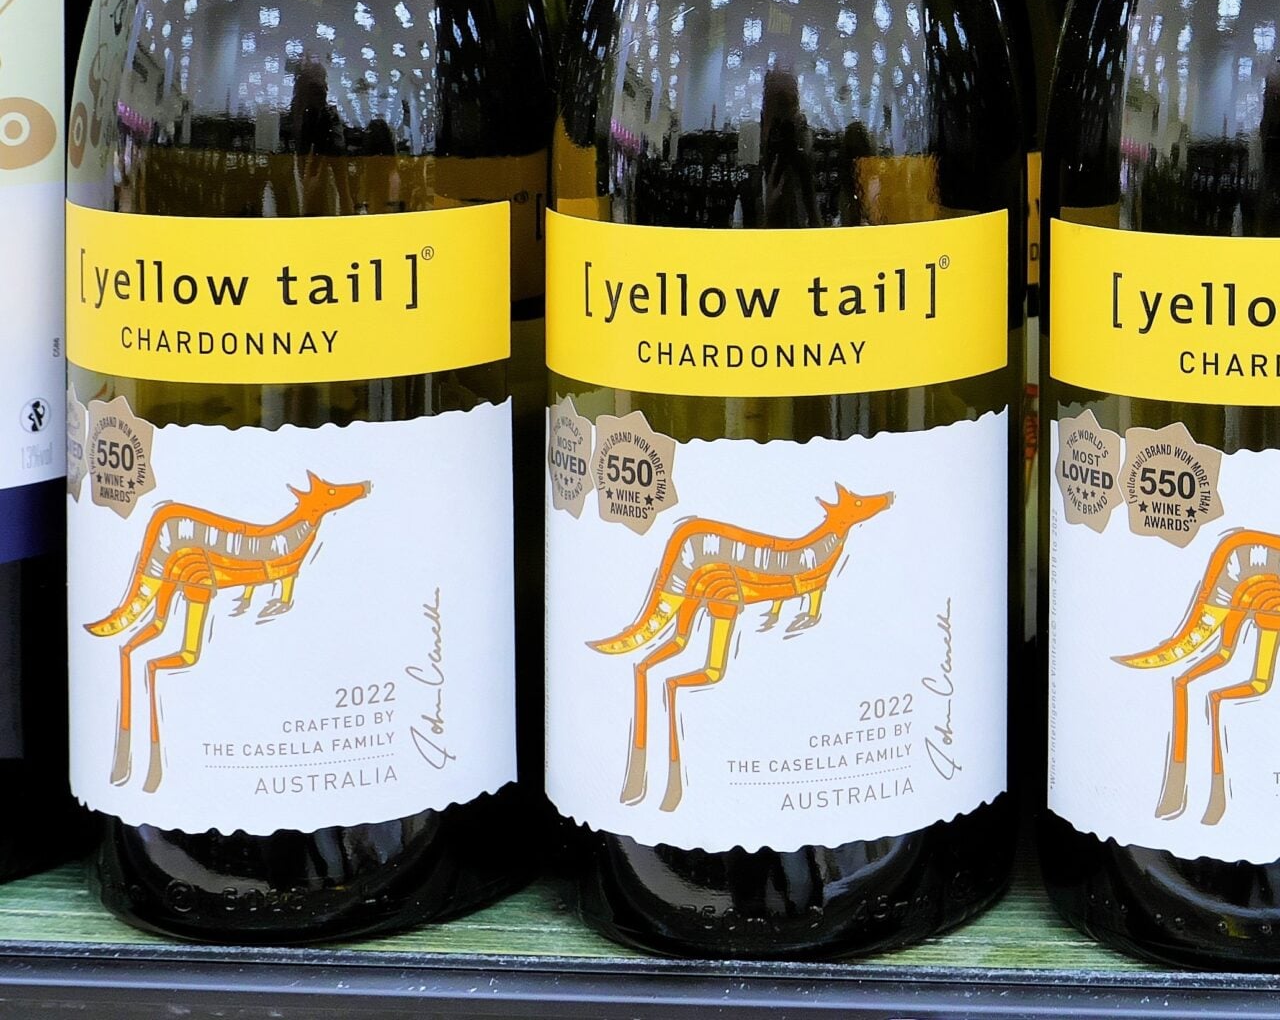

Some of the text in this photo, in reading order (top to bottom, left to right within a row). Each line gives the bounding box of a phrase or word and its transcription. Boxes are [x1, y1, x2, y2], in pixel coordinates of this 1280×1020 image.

[121, 326, 338, 355] CHARDONNAY
[637, 340, 866, 368] CHARDONNAY
[557, 436, 577, 452] MOST
[1067, 431, 1078, 449] THE
[1144, 443, 1172, 458] BRAND
[97, 439, 134, 471] 550
[551, 447, 586, 476] LOVED
[1072, 449, 1100, 467] MOST
[1174, 446, 1194, 465] WON
[104, 472, 124, 488] WINE
[607, 454, 653, 487] 550
[1062, 460, 1114, 490] LOVED
[1140, 467, 1196, 500] 550
[1190, 462, 1210, 488] MORE
[616, 488, 640, 503] WINE
[1067, 484, 1082, 511] WINE
[1198, 489, 1211, 515] THAN
[1152, 501, 1181, 517] WINE
[335, 682, 396, 708] 2022
[859, 693, 914, 721] 2022
[282, 710, 395, 734] CRAFTED BY
[809, 722, 912, 748] CRAFTED BY
[203, 732, 395, 757] THE CASELLA FAMILY
[727, 743, 912, 773] THE CASELLA FAMILY
[254, 765, 398, 795] AUSTRALIA
[781, 777, 914, 811] AUSTRALIA
